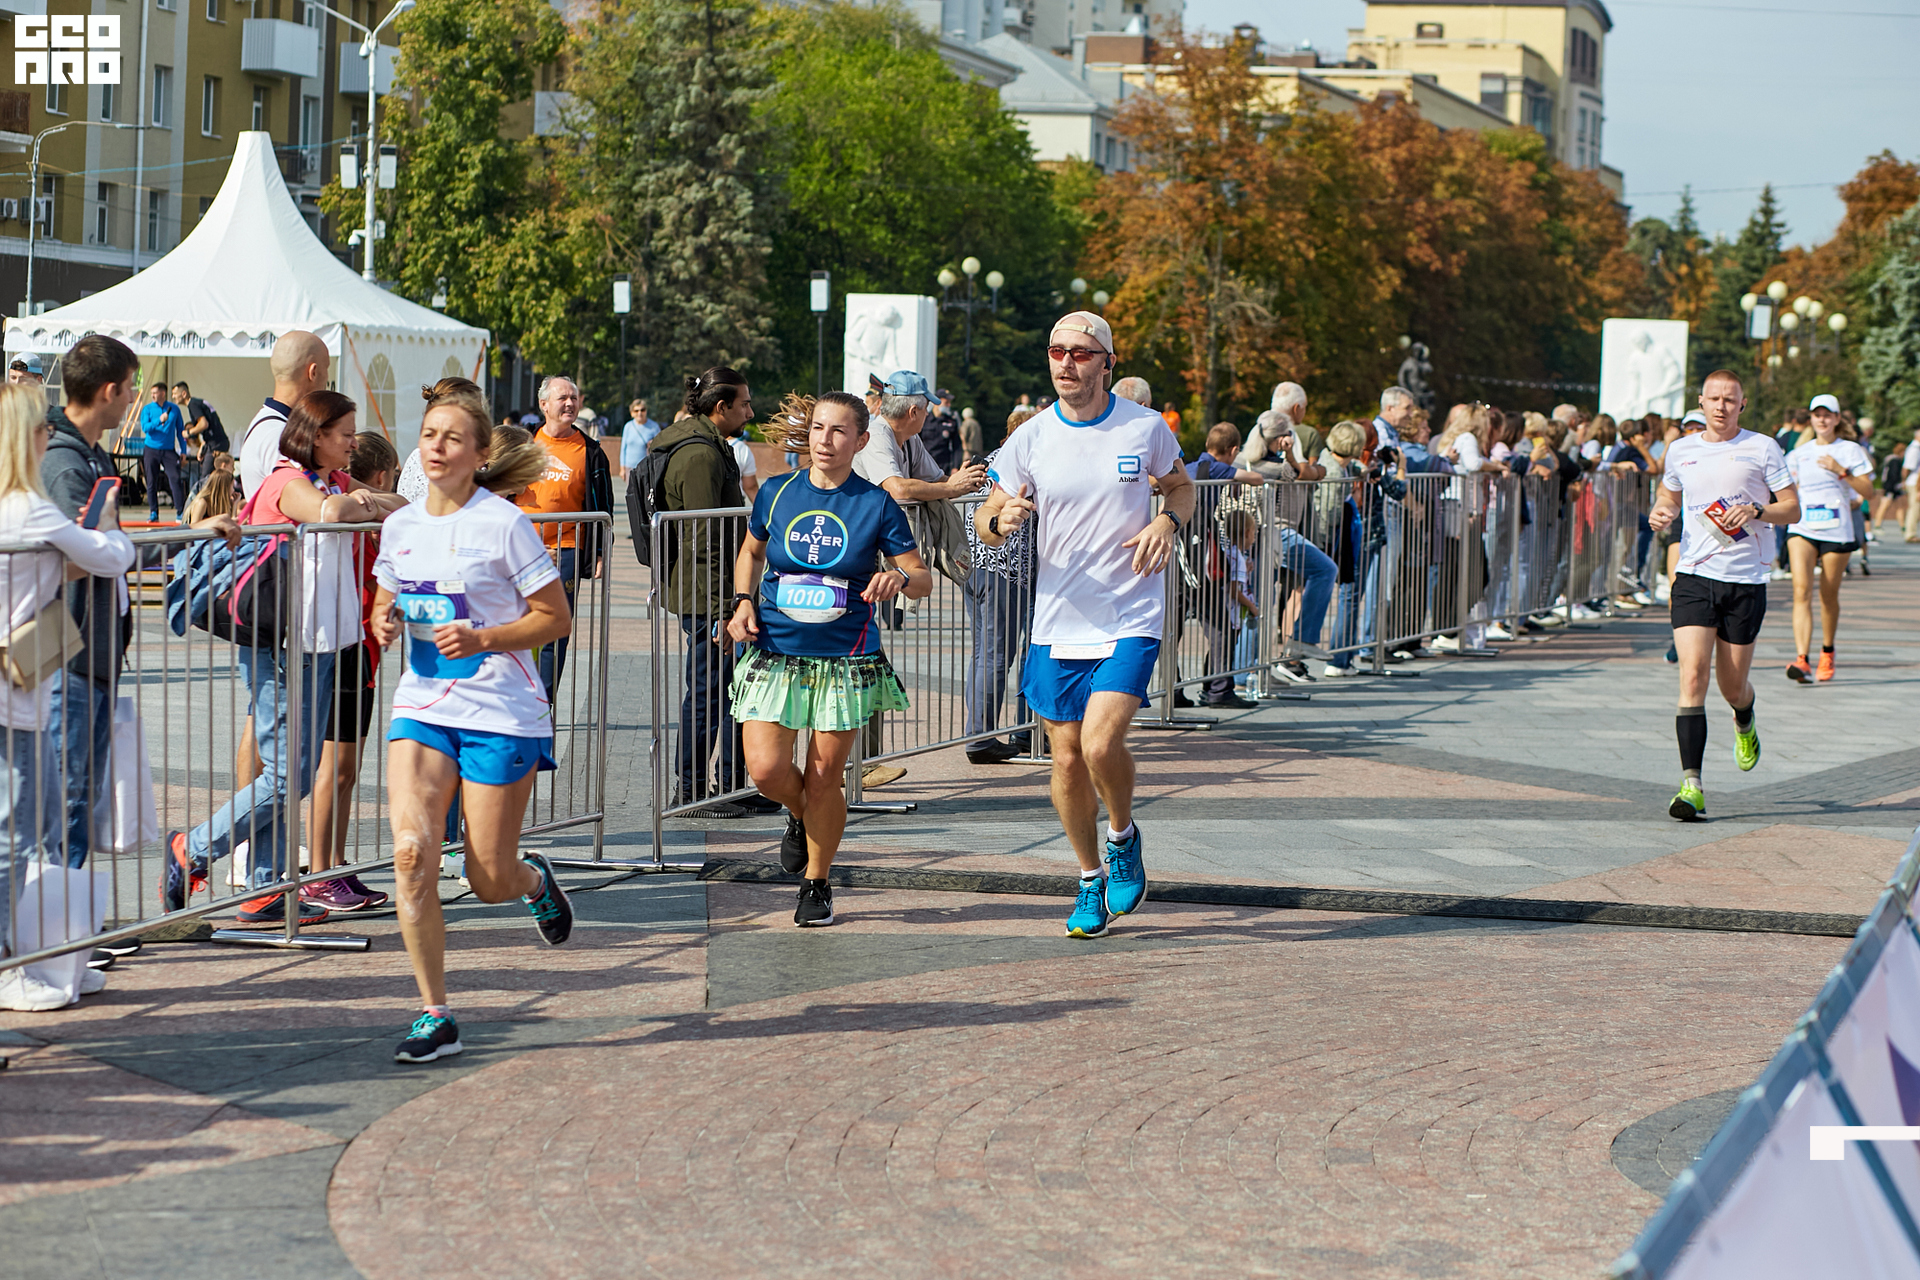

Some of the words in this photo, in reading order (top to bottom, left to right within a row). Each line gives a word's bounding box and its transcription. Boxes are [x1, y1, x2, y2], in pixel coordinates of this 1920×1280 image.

[789, 530, 843, 547] BAYER
[805, 515, 826, 565] BAYER
[786, 588, 826, 607] 1010
[407, 598, 448, 620] 1095
